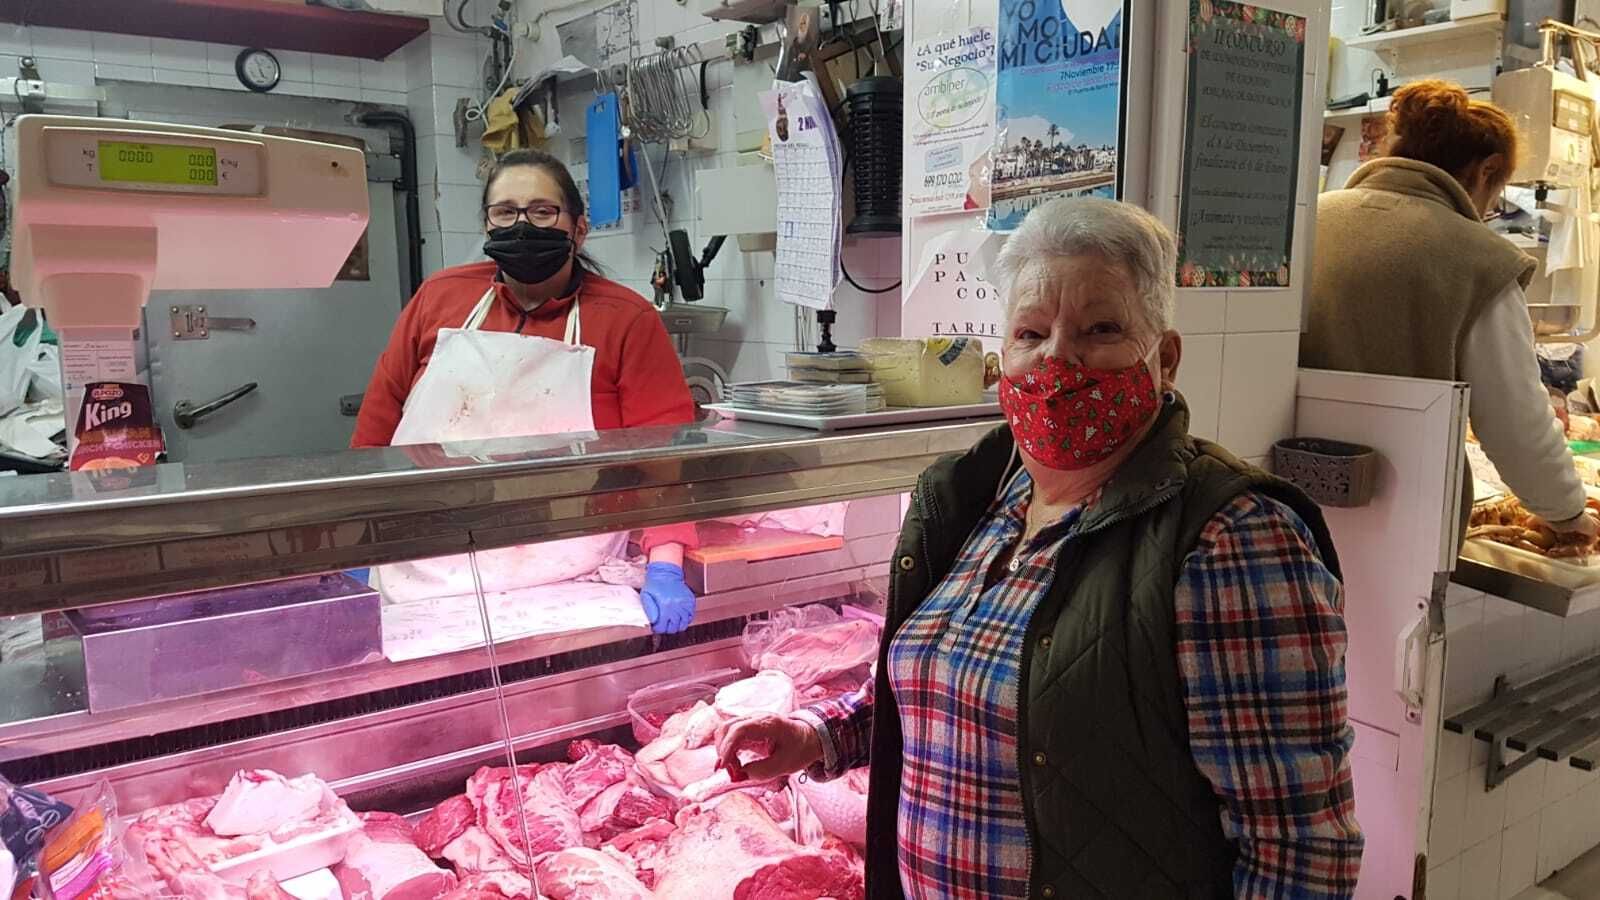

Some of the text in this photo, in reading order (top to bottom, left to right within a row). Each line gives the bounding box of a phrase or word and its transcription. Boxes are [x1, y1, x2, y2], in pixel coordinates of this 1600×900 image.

[935, 39, 956, 55] qué
[958, 30, 991, 47] huele
[1000, 43, 1027, 71] MI
[85, 401, 132, 431] King
